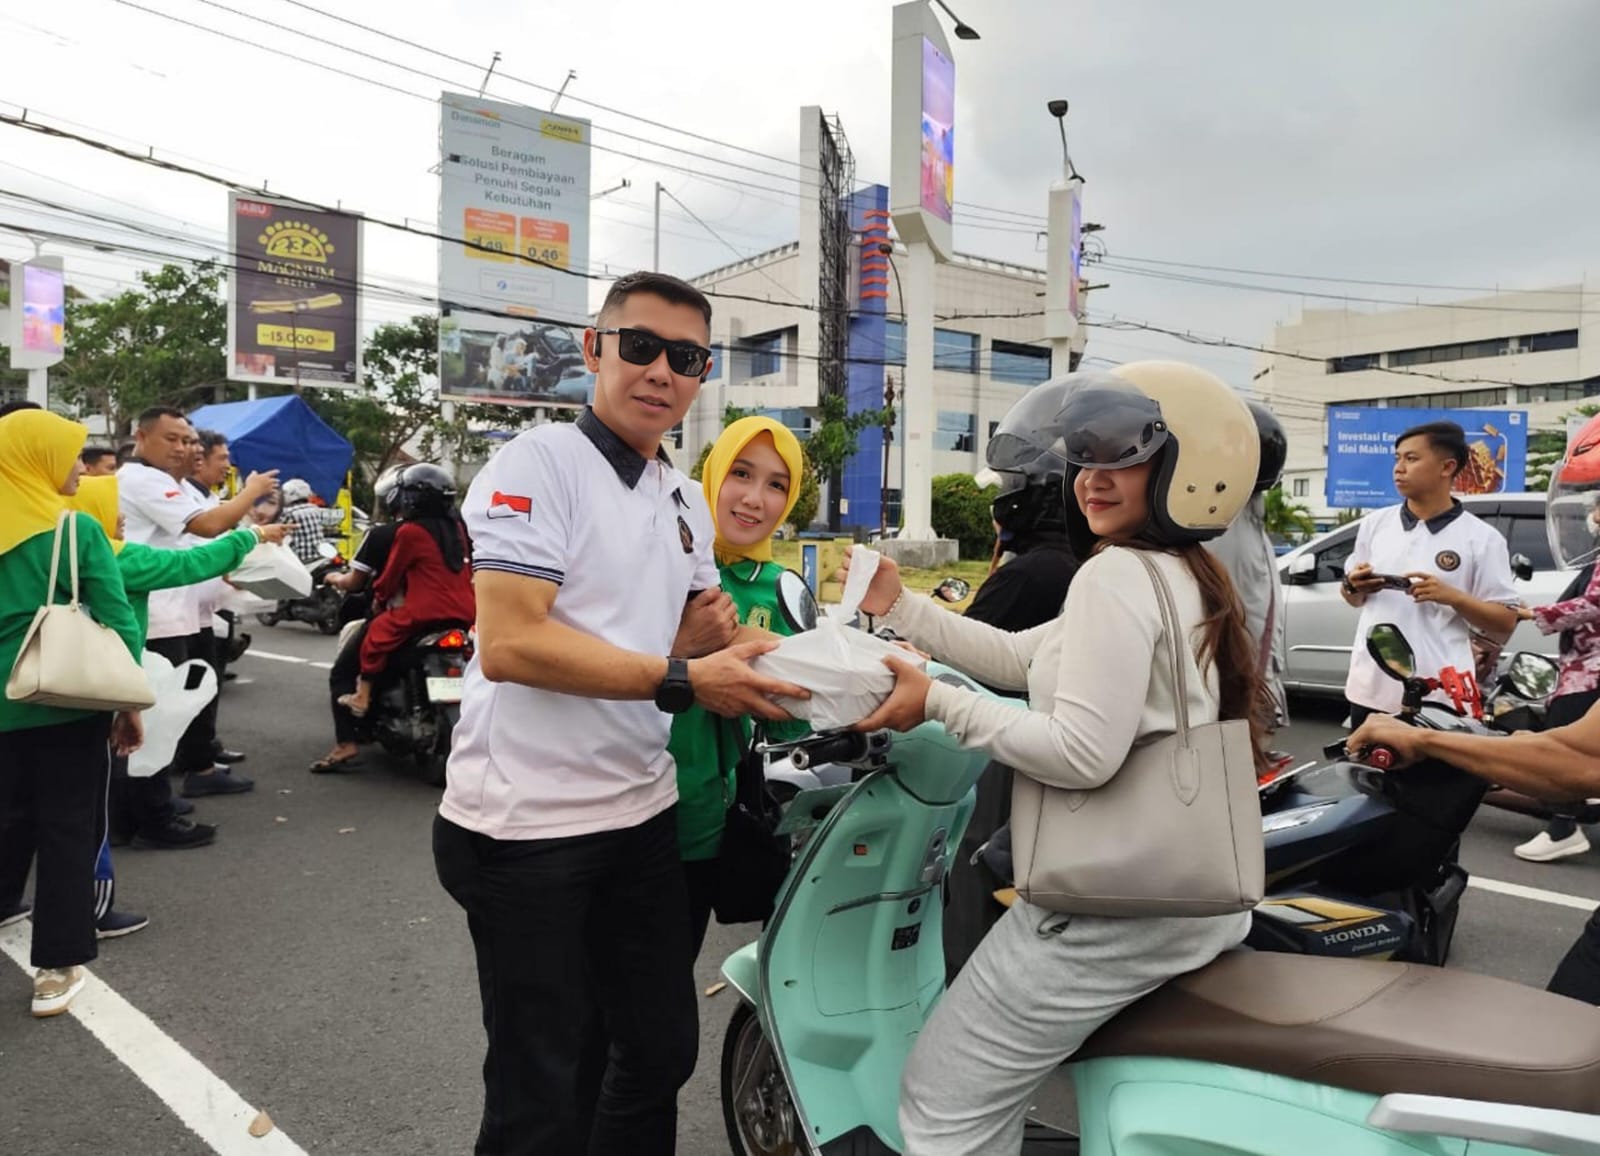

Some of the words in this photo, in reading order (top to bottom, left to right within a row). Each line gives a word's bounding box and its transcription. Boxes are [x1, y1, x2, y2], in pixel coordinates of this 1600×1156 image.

[459, 154, 499, 171] Solusi
[491, 145, 547, 165] Beragam
[501, 162, 576, 185] Pembiayaan
[474, 173, 518, 190] Penuhi
[520, 180, 561, 198] Segala
[484, 190, 552, 211] Kebutuhan
[273, 237, 319, 257] 234
[258, 261, 335, 279] MAGNUM
[1338, 431, 1380, 442] Investasi
[1338, 443, 1357, 454] Kini
[1359, 443, 1389, 454] Makin
[1322, 923, 1391, 945] HONDA
